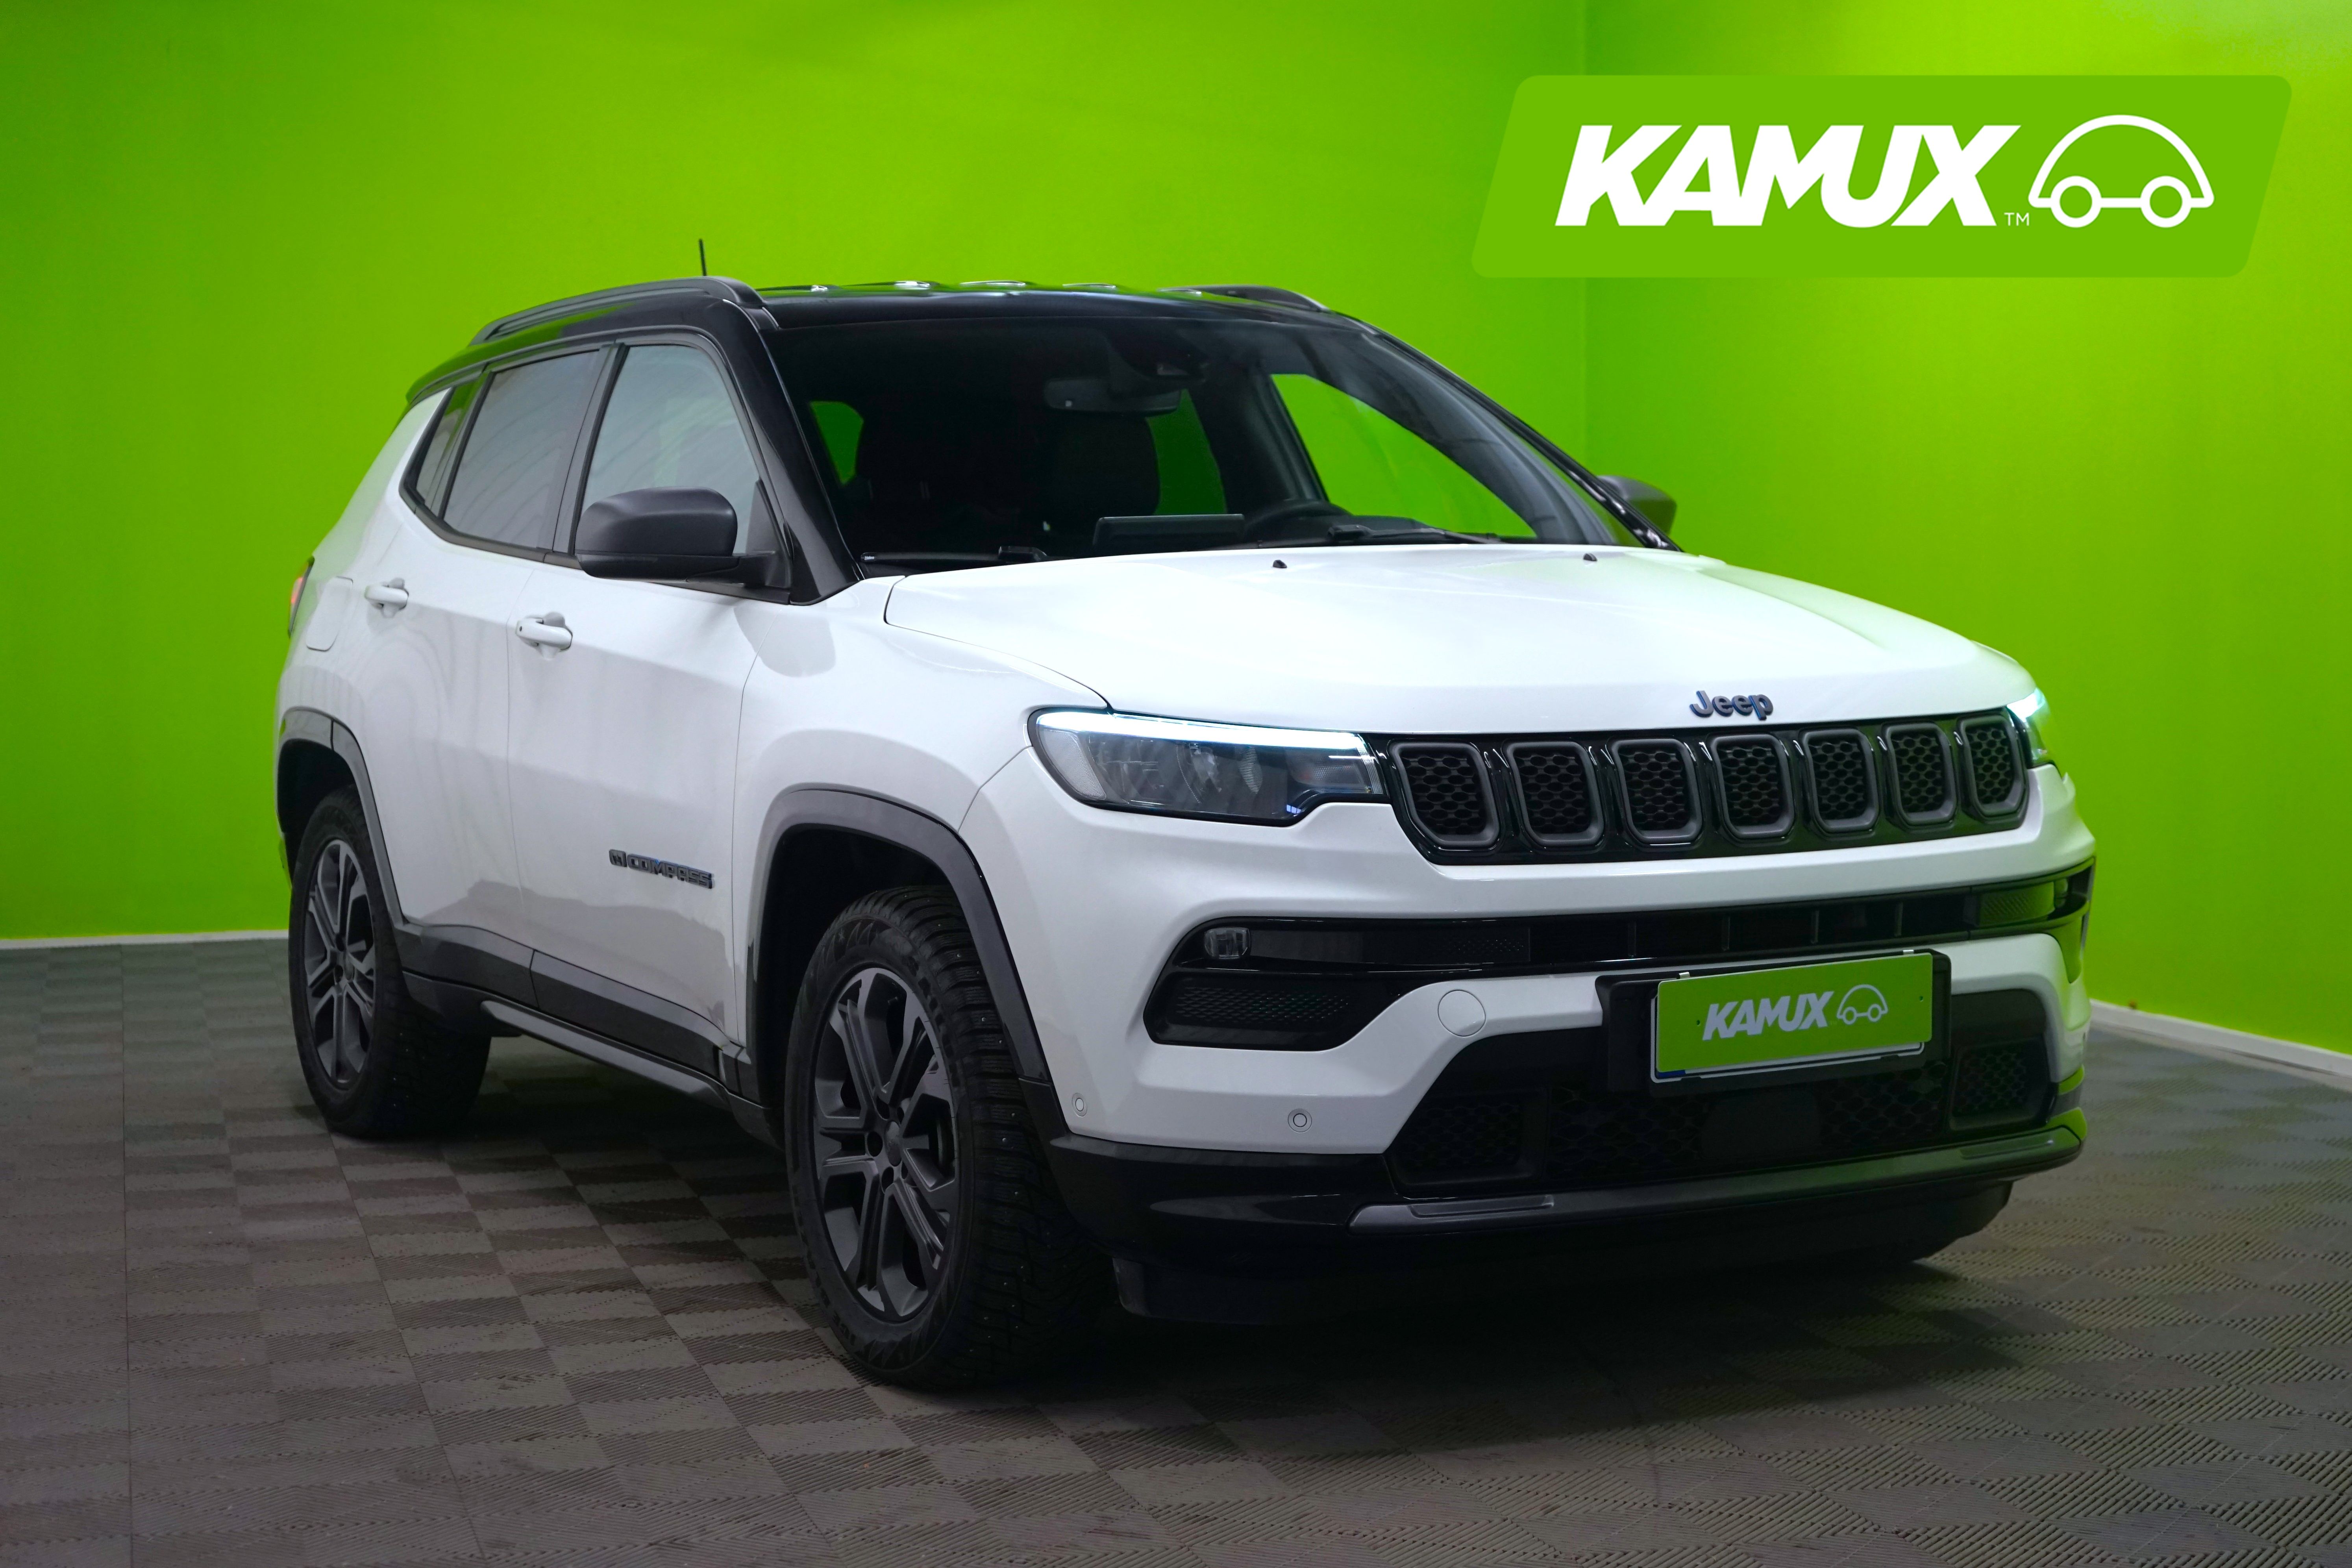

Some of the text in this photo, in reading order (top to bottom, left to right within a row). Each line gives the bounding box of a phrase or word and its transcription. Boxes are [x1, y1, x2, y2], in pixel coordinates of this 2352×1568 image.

[1689, 690, 1773, 721] Jeep
[627, 853, 713, 889] COMPASS
[1702, 991, 1834, 1041] KAMUX
